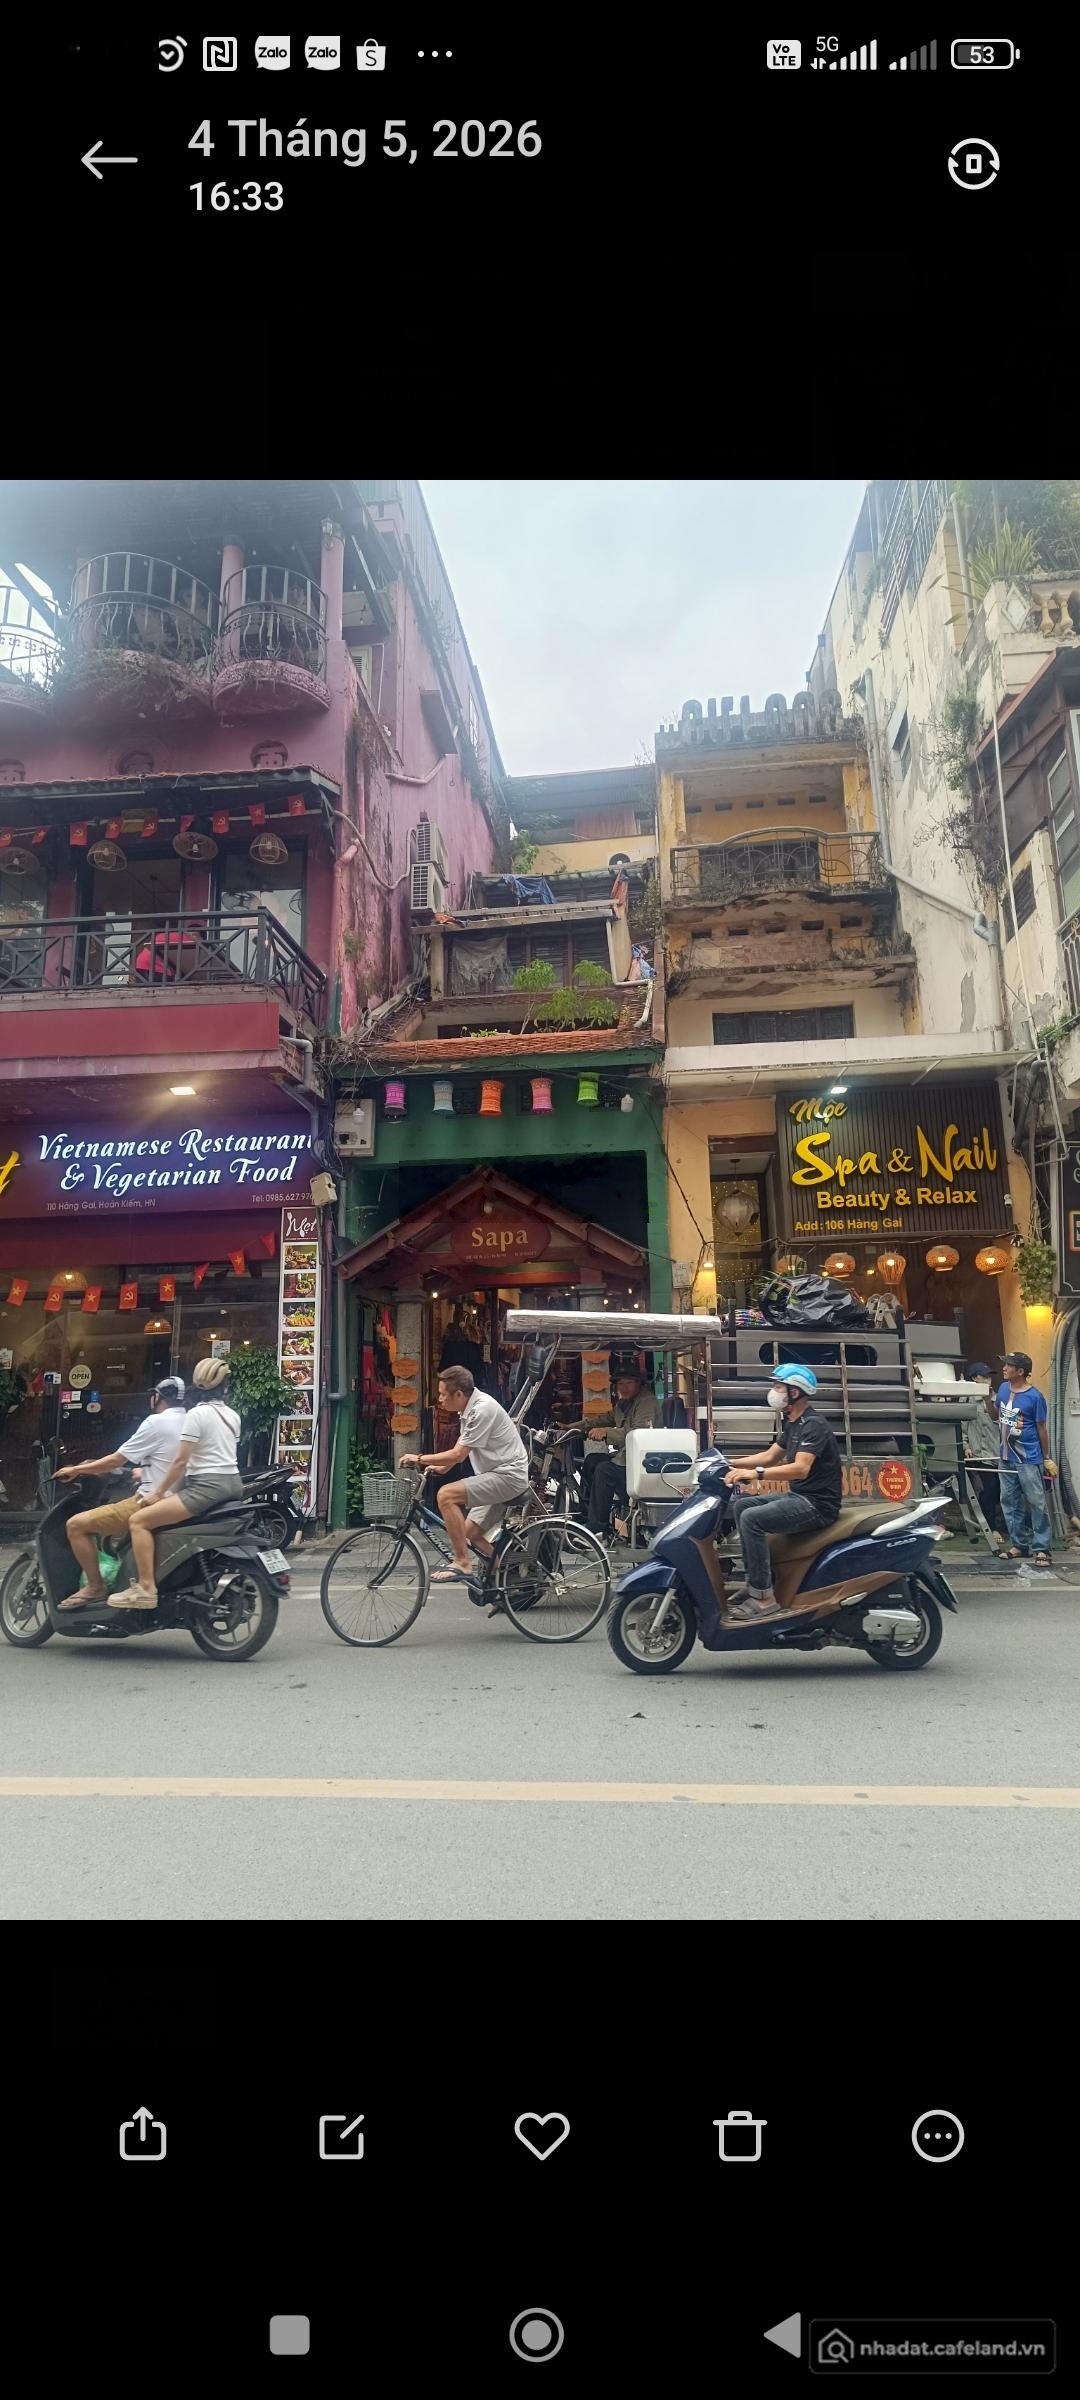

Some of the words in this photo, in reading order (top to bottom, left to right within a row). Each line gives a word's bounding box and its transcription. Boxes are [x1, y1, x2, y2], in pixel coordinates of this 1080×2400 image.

[788, 1097, 849, 1124] Mộc
[38, 1132, 172, 1161] Vietnamese
[791, 1132, 881, 1187] Spa
[887, 1148, 914, 1173] &
[916, 1124, 998, 1183] Nail
[60, 1163, 85, 1191] &
[92, 1162, 222, 1197] Vegetarian
[229, 1155, 298, 1184] Food
[816, 1191, 891, 1211] Beauty
[895, 1188, 911, 1206] &
[917, 1188, 978, 1206] Relax
[847, 1218, 878, 1231] Hàng
[882, 1216, 903, 1228] Gai
[470, 1227, 529, 1252] Sapa
[71, 1373, 90, 1381] OPEN
